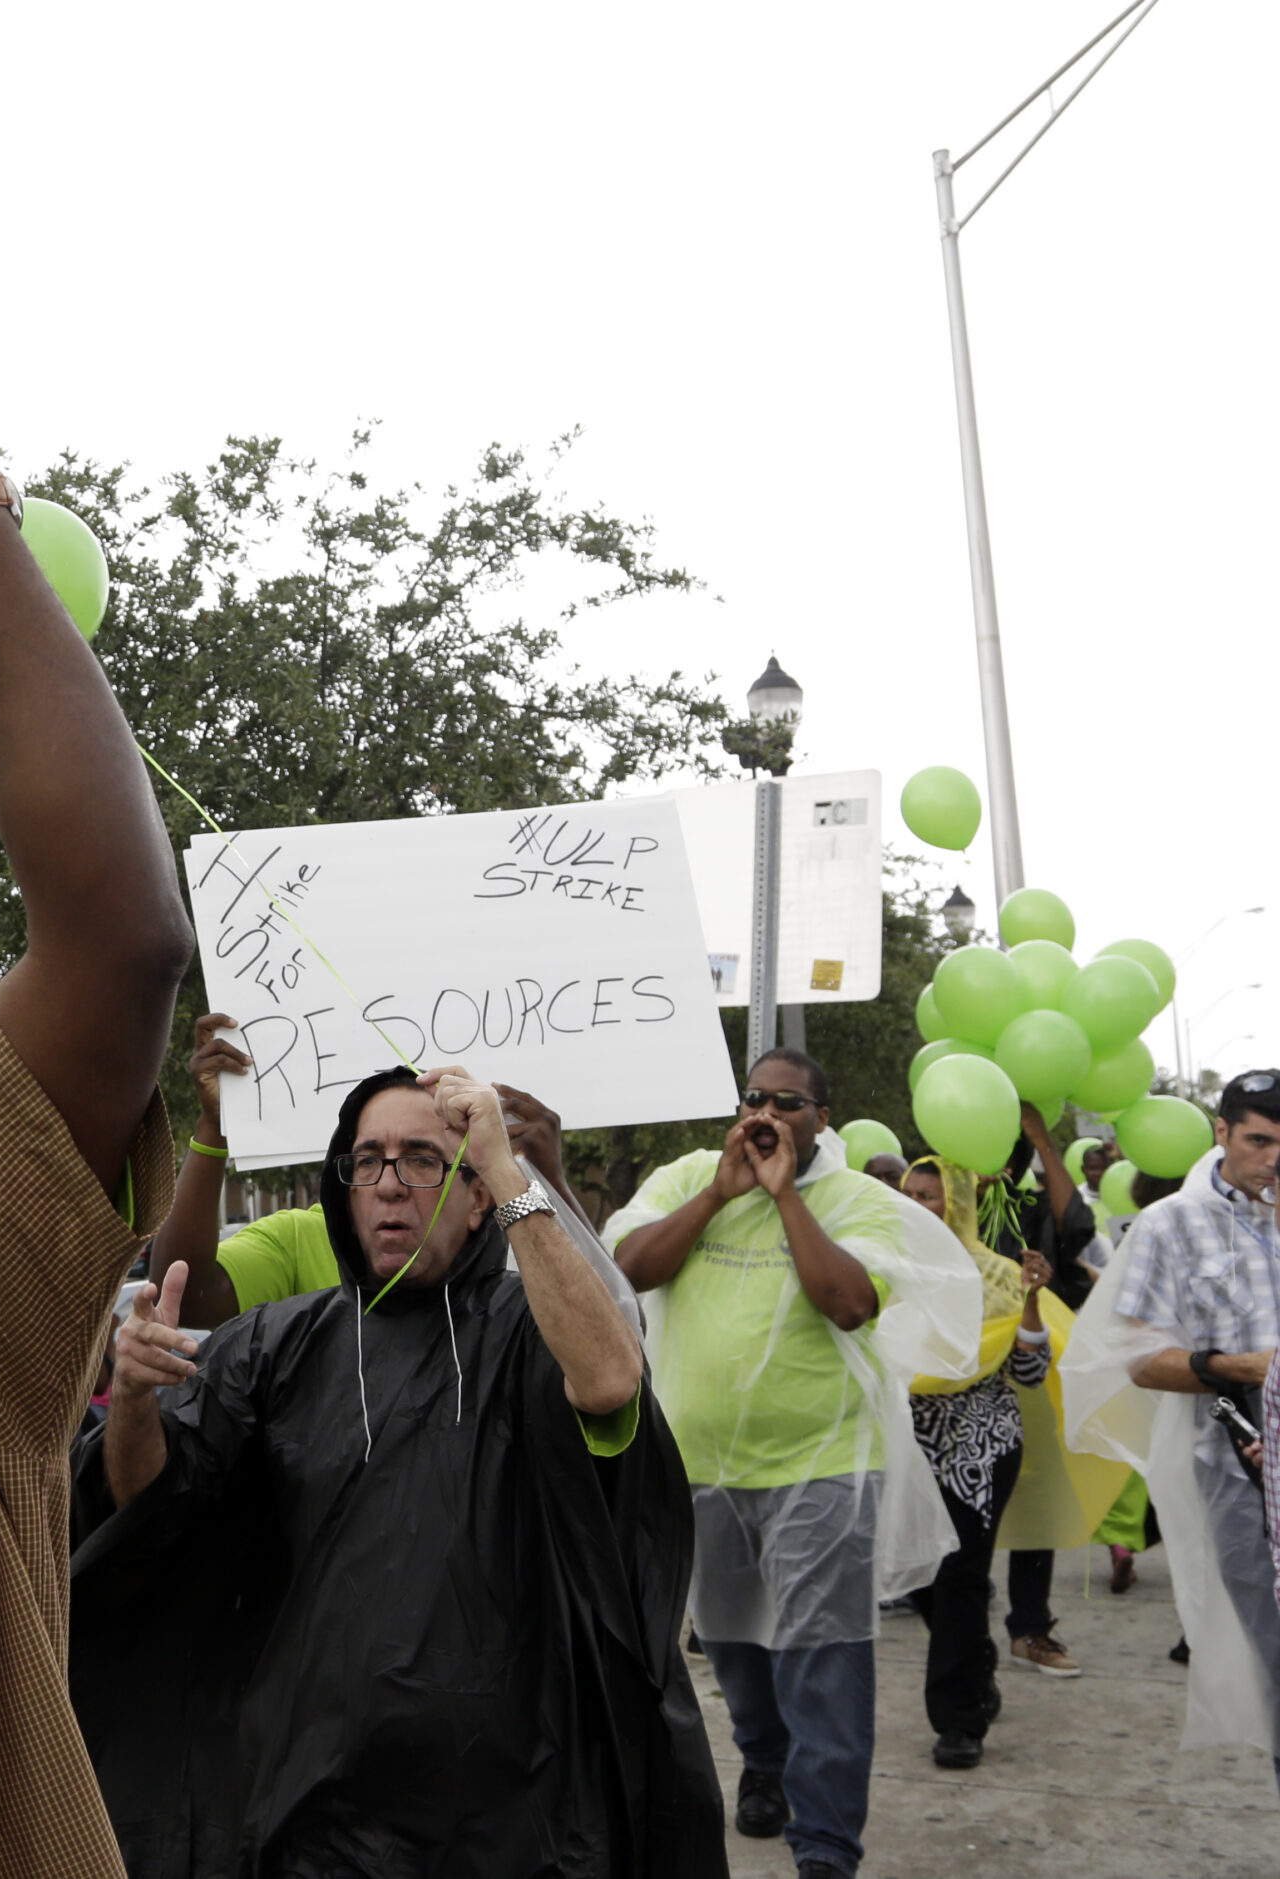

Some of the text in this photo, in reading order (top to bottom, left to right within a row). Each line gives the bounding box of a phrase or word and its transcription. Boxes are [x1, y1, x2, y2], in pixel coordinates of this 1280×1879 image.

[216, 864, 322, 979] Strike
[473, 862, 646, 912] STRIKE
[255, 947, 307, 1005] For
[239, 975, 676, 1121] RESOURCES
